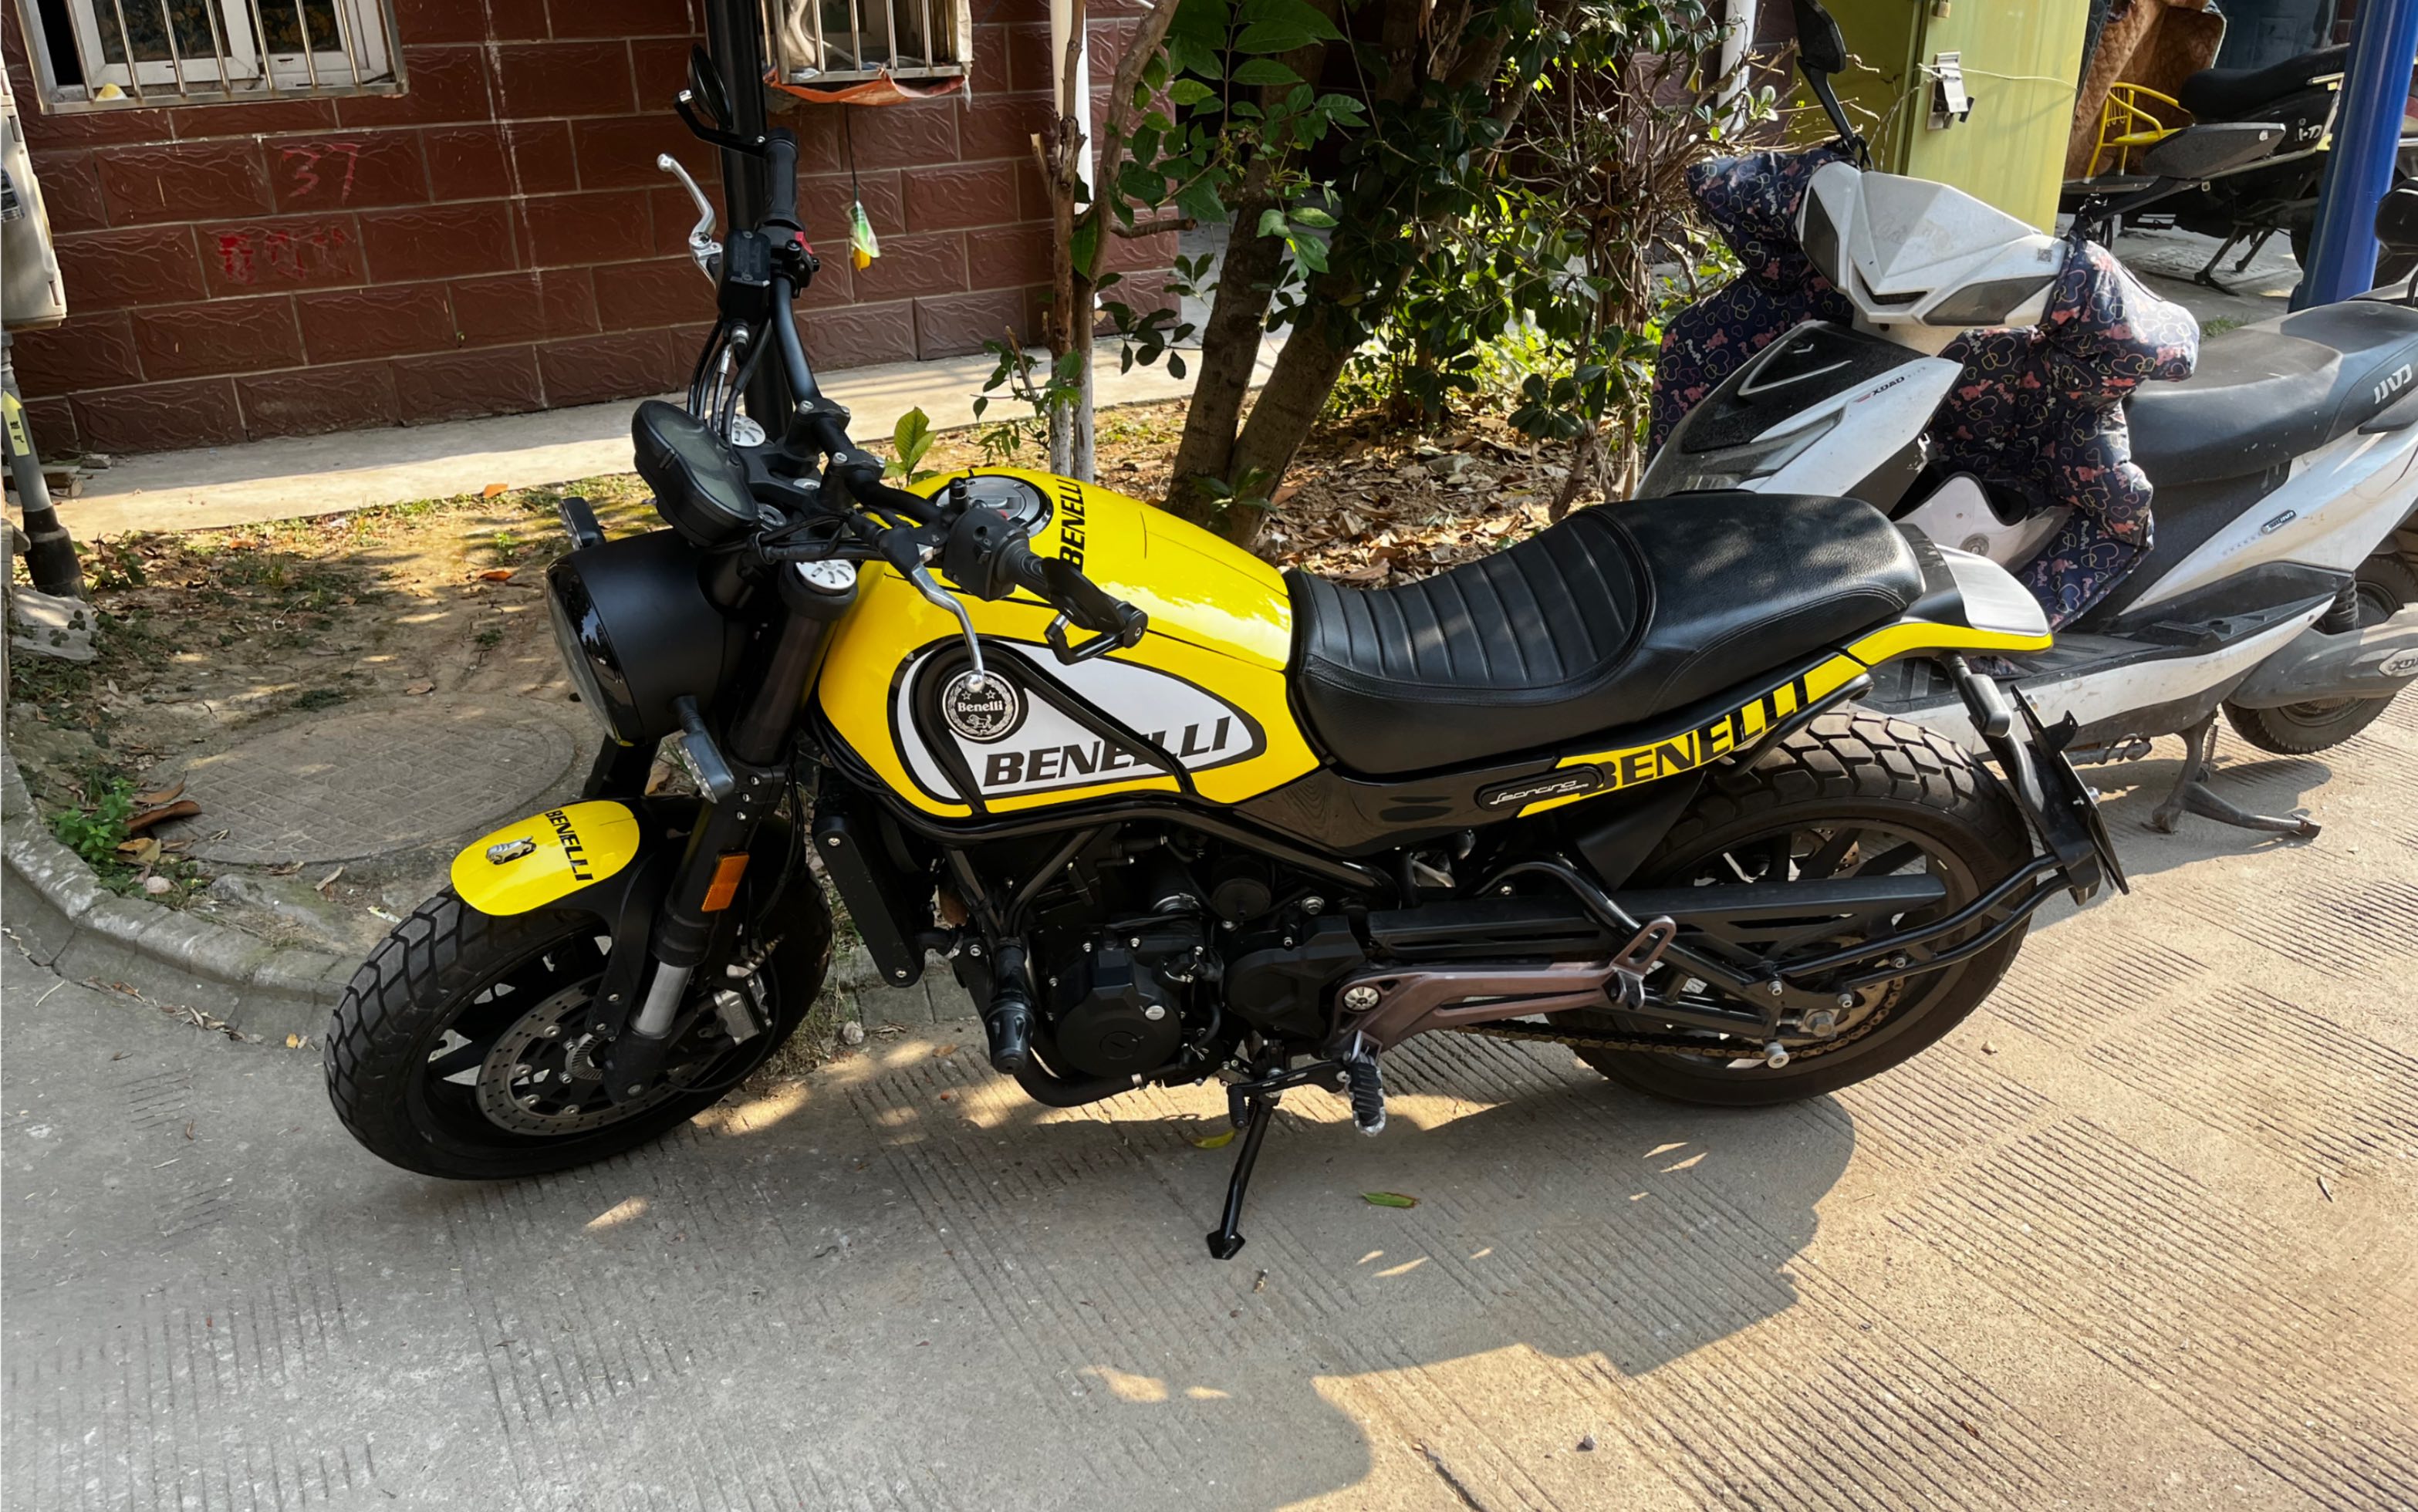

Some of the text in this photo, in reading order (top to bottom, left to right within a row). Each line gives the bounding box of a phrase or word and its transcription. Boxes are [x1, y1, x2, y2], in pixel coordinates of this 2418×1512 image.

[282, 143, 359, 204] 37
[1055, 478, 1085, 573] BENELLI
[957, 700, 1003, 712] Benelli
[545, 810, 593, 881] BENELLI
